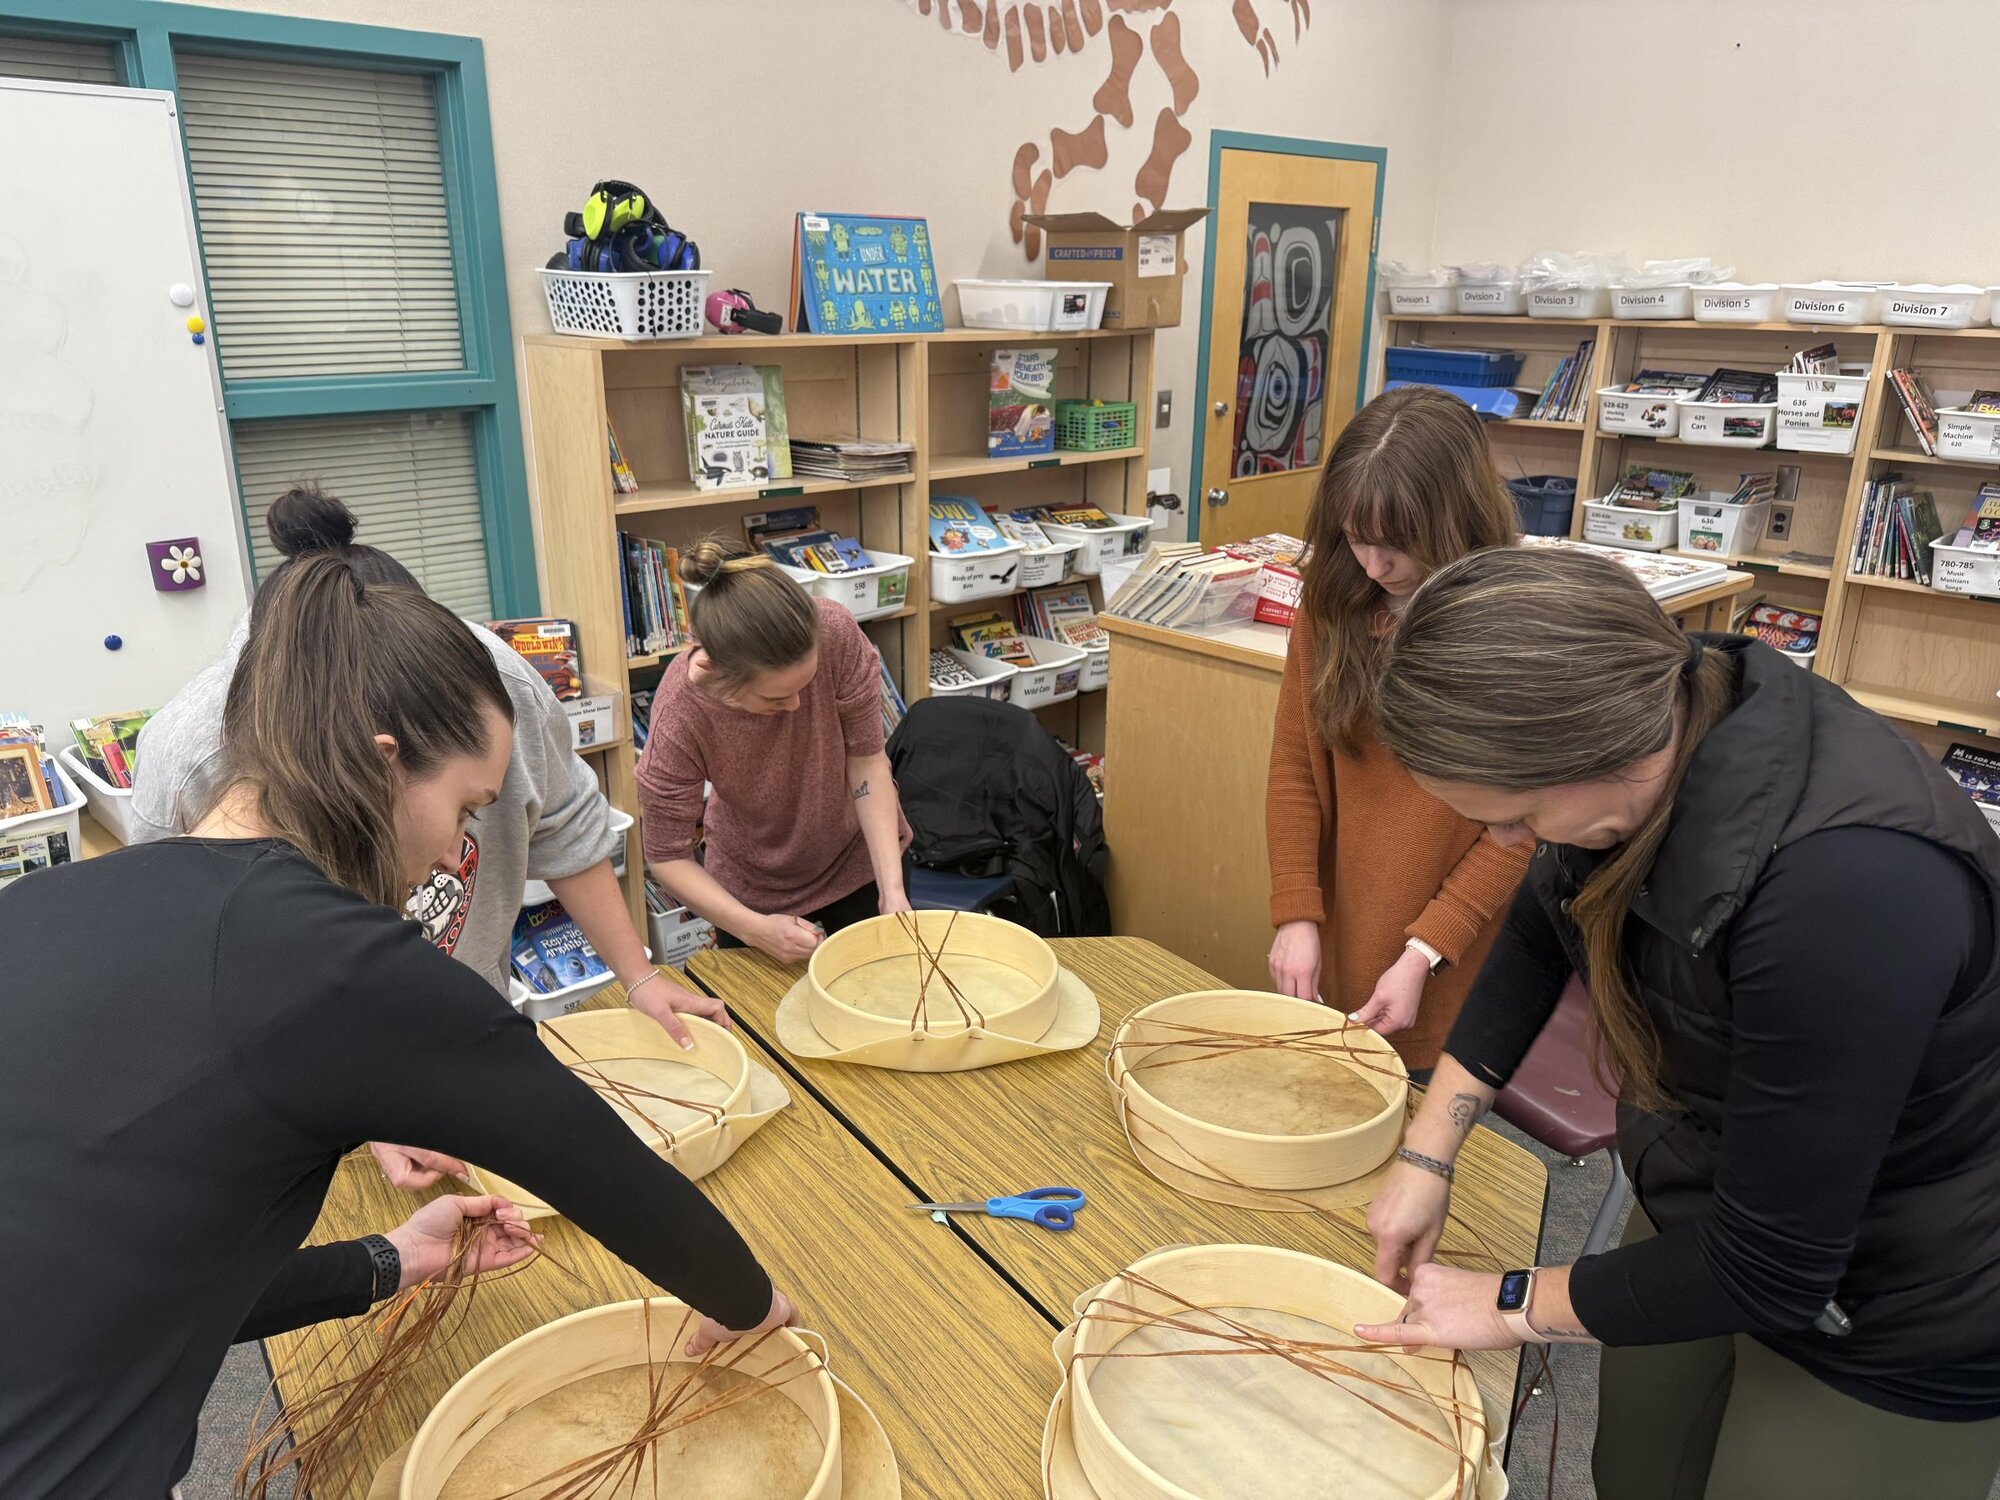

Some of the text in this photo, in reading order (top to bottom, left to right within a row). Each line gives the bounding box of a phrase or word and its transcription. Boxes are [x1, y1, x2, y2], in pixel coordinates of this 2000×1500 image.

[860, 245, 885, 262] UNDER
[1054, 248, 1086, 258] CRAFTED
[1094, 248, 1116, 258] PRIDE
[832, 267, 919, 294] WATER
[1396, 295, 1430, 304] Division 1
[1464, 292, 1501, 301] Division 2
[1534, 295, 1574, 305] Division 3
[1620, 294, 1665, 305] Division 4
[1704, 299, 1750, 308] Division 5
[1794, 300, 1845, 312] Division 6
[1892, 302, 1948, 316] Division 7
[1018, 352, 1040, 362] STARS
[1015, 361, 1046, 372] BENEATH
[1014, 370, 1044, 382] YOUR BED
[1778, 408, 1820, 418] Horses and
[1691, 422, 1707, 431] Cars
[1784, 419, 1810, 427] Ponies
[1947, 423, 1972, 432] Simple
[705, 429, 760, 440] NATURE GUIDE
[1942, 432, 1974, 440] Machine
[928, 503, 977, 520] OWL
[1100, 548, 1115, 556] Bears
[1940, 560, 1975, 569] 780-785
[514, 640, 542, 652] WOULD
[543, 637, 564, 650] WIN?
[1024, 686, 1051, 696] Wild Cats
[1953, 748, 1966, 758] M
[1974, 756, 1989, 764] FOR
[540, 928, 583, 950] Reptile
[676, 932, 692, 944] 599
[564, 1000, 581, 1012] 597
